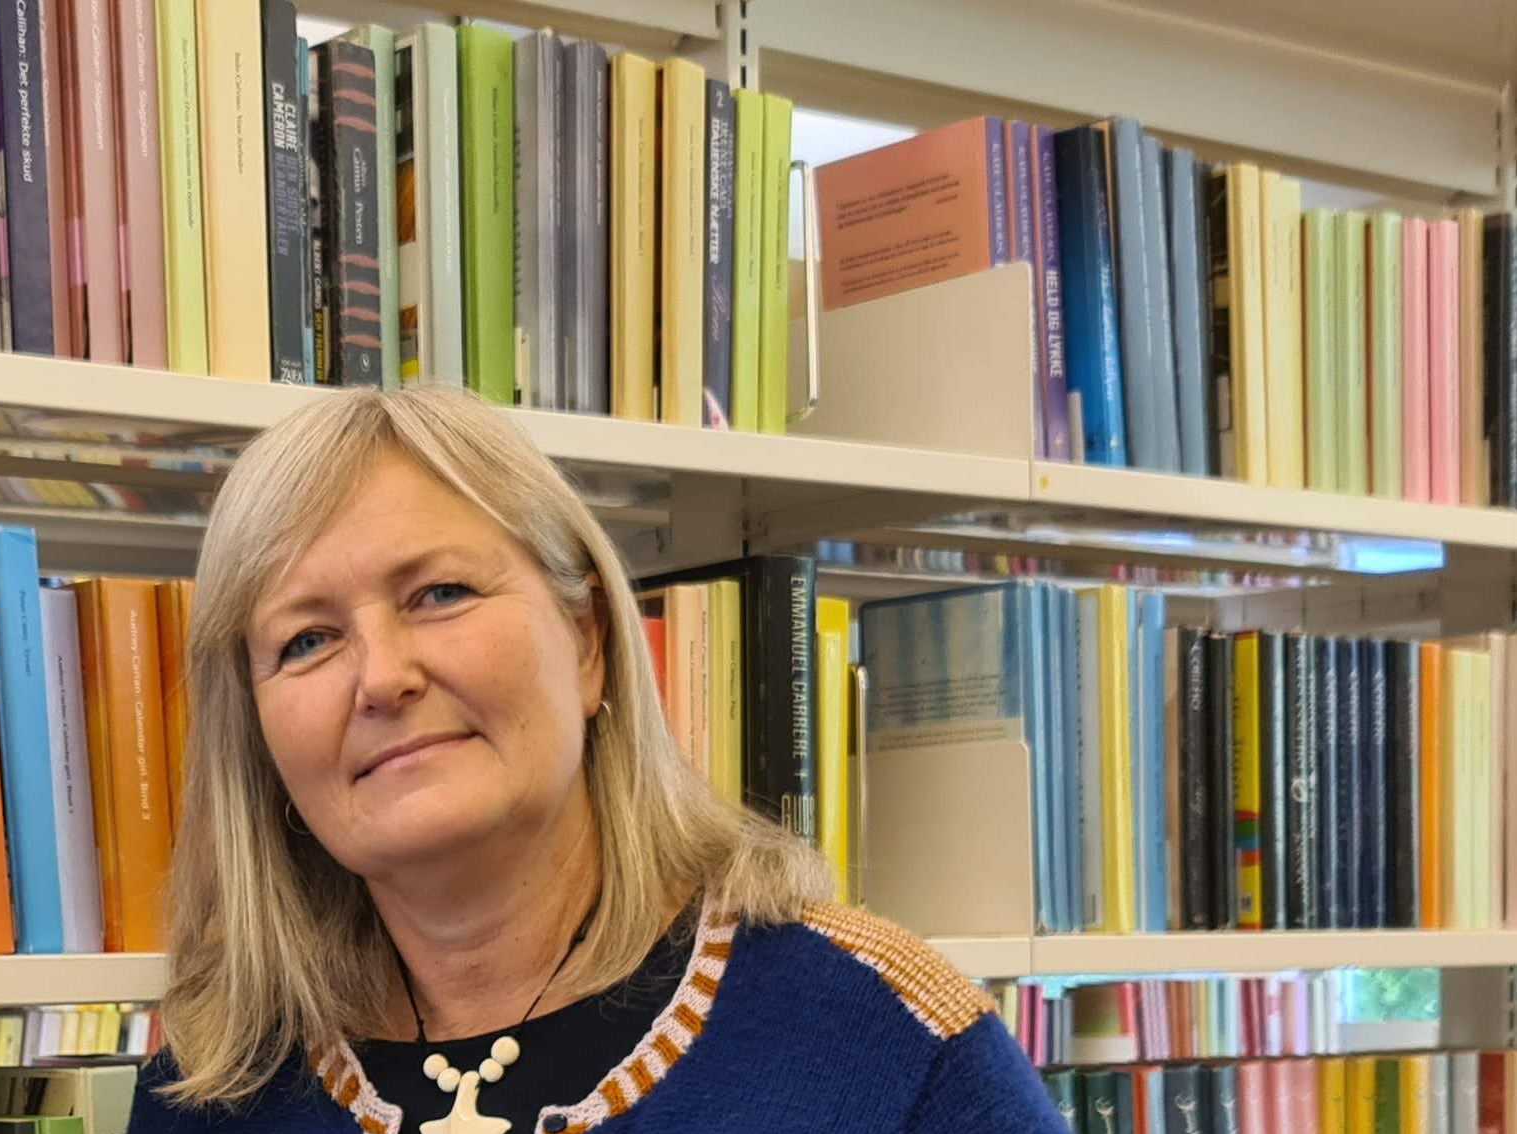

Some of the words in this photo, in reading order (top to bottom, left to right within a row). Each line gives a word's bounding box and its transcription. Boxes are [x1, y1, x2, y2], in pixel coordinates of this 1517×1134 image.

[18, 62, 29, 86] Det
[17, 89, 32, 146] perfekte
[272, 83, 285, 148] CAMERON
[285, 103, 298, 152] CLAIRE
[21, 150, 33, 182] skud
[353, 202, 366, 245] Pesten
[1046, 270, 1061, 307] HELD
[1049, 335, 1063, 378] LYKKE
[790, 575, 808, 674] EMMANUEL
[134, 701, 147, 754] Calendar
[140, 782, 151, 810] Bind
